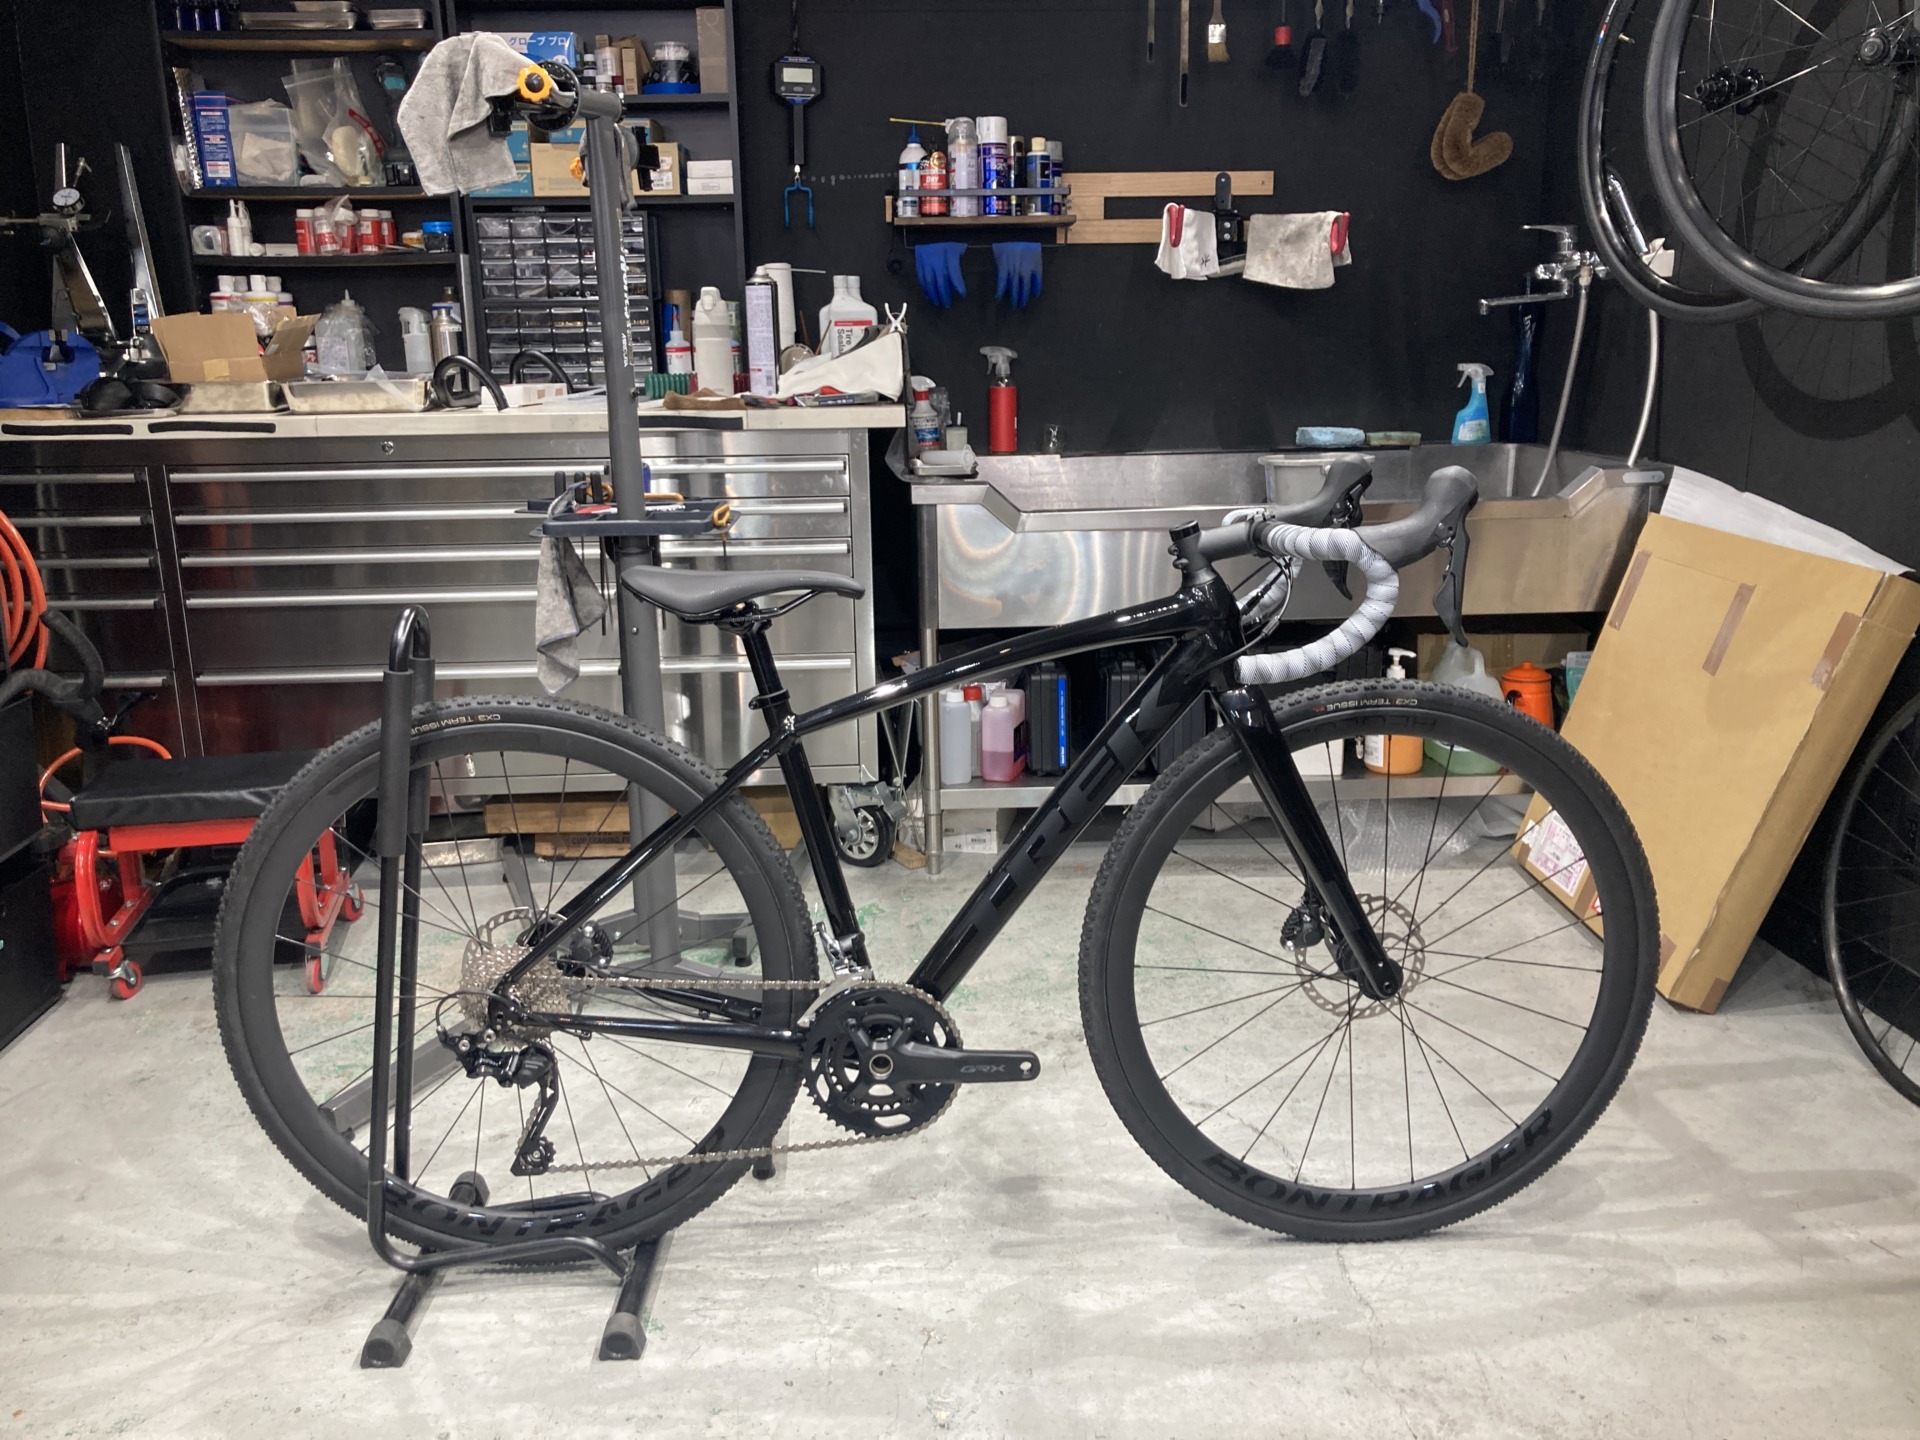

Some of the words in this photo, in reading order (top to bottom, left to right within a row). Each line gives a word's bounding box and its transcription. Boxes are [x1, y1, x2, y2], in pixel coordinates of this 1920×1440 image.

[837, 328, 846, 354] Seala
[845, 328, 853, 346] Tire
[1326, 700, 1358, 712] ISSUE
[1360, 698, 1391, 706] TEAM
[1395, 698, 1418, 706] CX3
[441, 716, 474, 727] TEAM
[478, 713, 501, 721] CX3
[960, 1064, 1006, 1073] GRX
[1200, 1105, 1554, 1214] BONTRAGER
